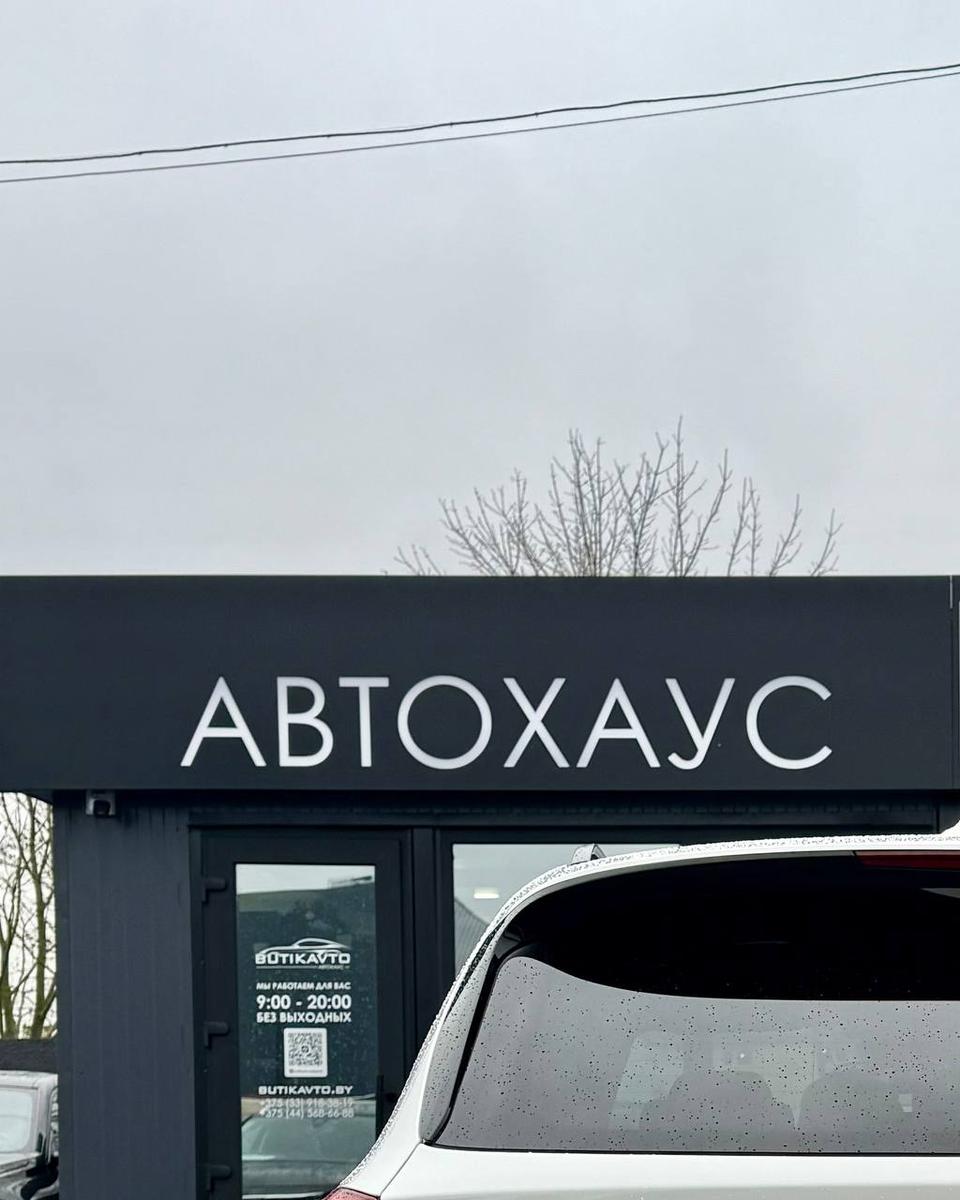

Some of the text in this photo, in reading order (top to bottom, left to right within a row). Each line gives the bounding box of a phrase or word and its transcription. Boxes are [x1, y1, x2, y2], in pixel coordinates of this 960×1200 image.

[181, 674, 834, 771] АВТОХАУС
[255, 953, 351, 965] BUTIKAVTO
[256, 981, 352, 990] МЫ РАБОТАЕМ ДЛЯ ВАС
[256, 994, 291, 1010] 9:00
[307, 994, 352, 1010] 20:00
[256, 1011, 352, 1024] БЕЗ ВЫХОДНЫХ
[258, 1085, 354, 1095] BUTIKAVTO.BY
